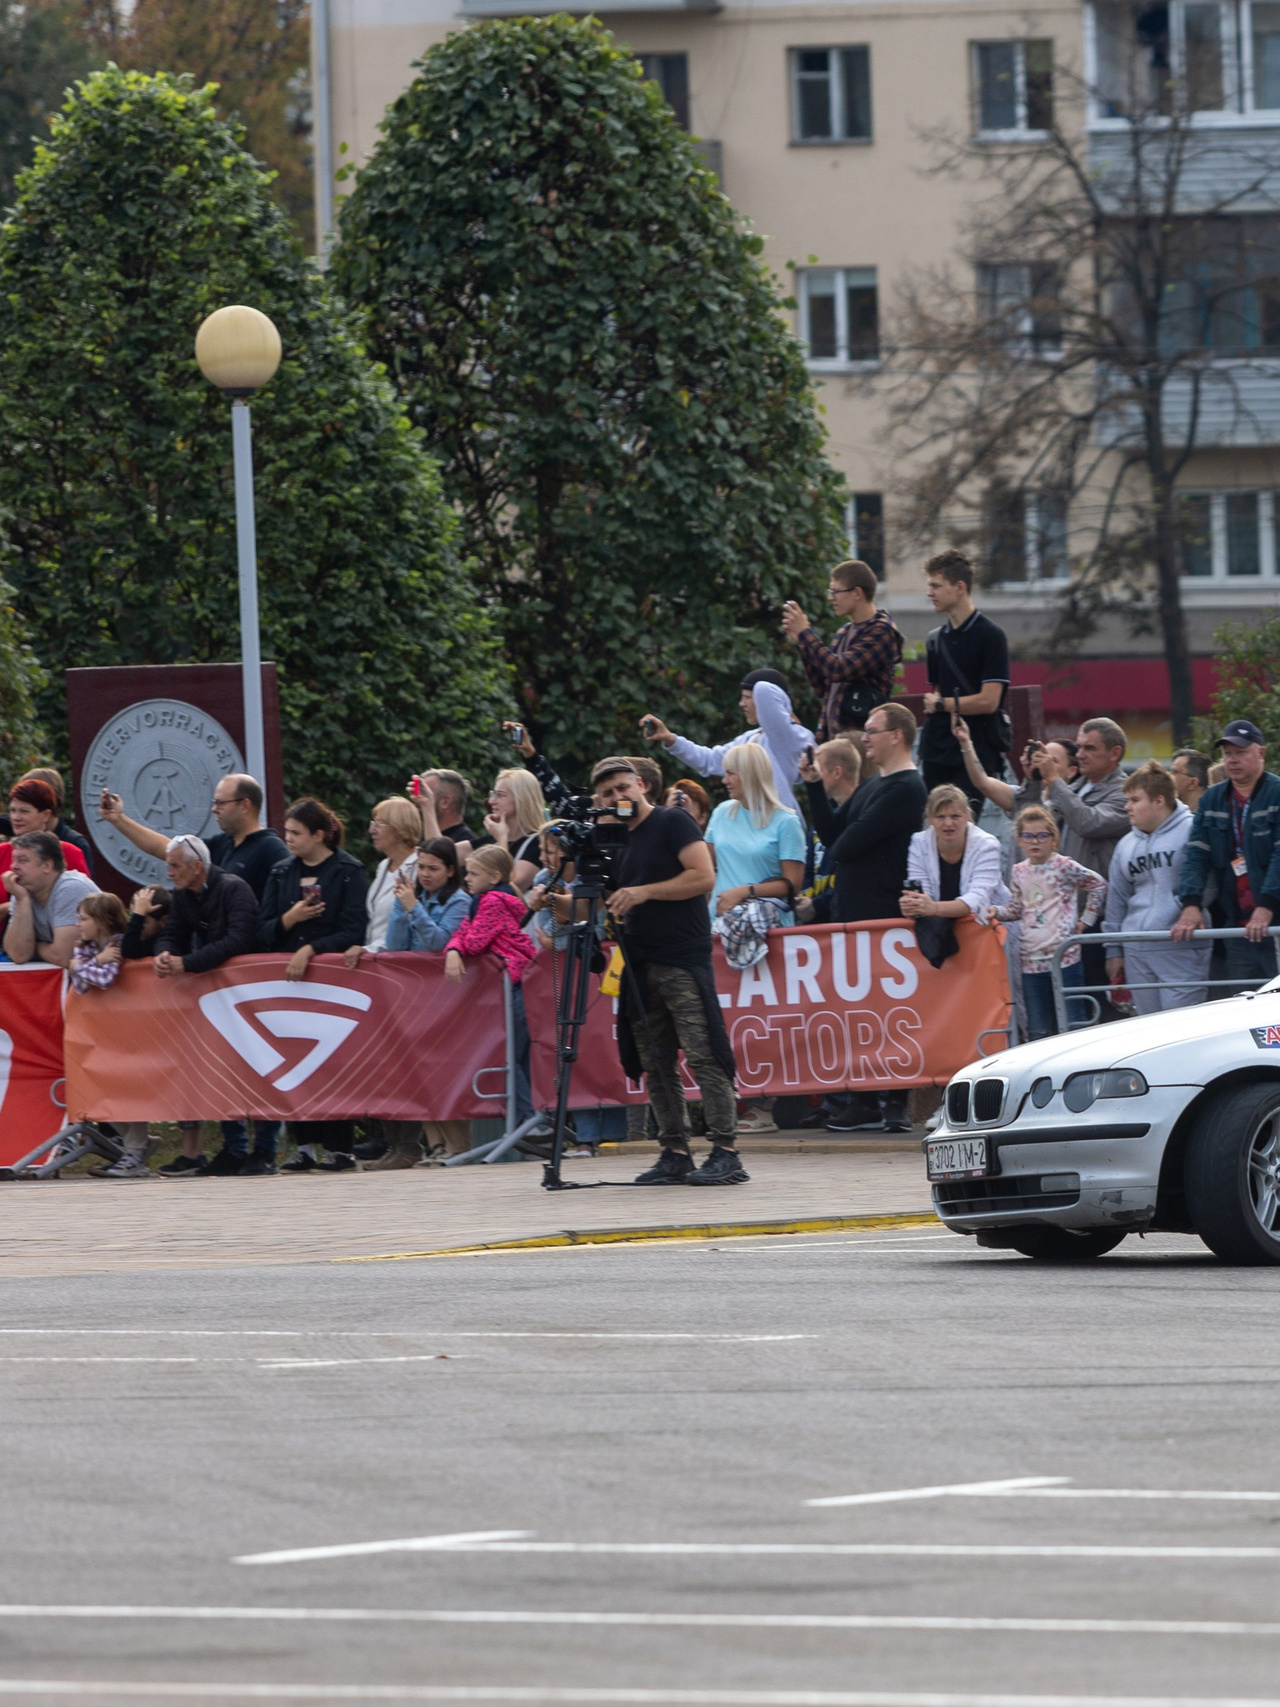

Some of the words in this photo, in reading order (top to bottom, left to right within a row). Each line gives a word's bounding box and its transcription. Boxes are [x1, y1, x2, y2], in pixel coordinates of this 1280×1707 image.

[94, 709, 237, 774] HERVORRAGEN
[1128, 850, 1176, 877] ARMY
[718, 927, 919, 1008] ARUS
[730, 1006, 925, 1089] CTORS
[934, 1145, 955, 1169] 3702
